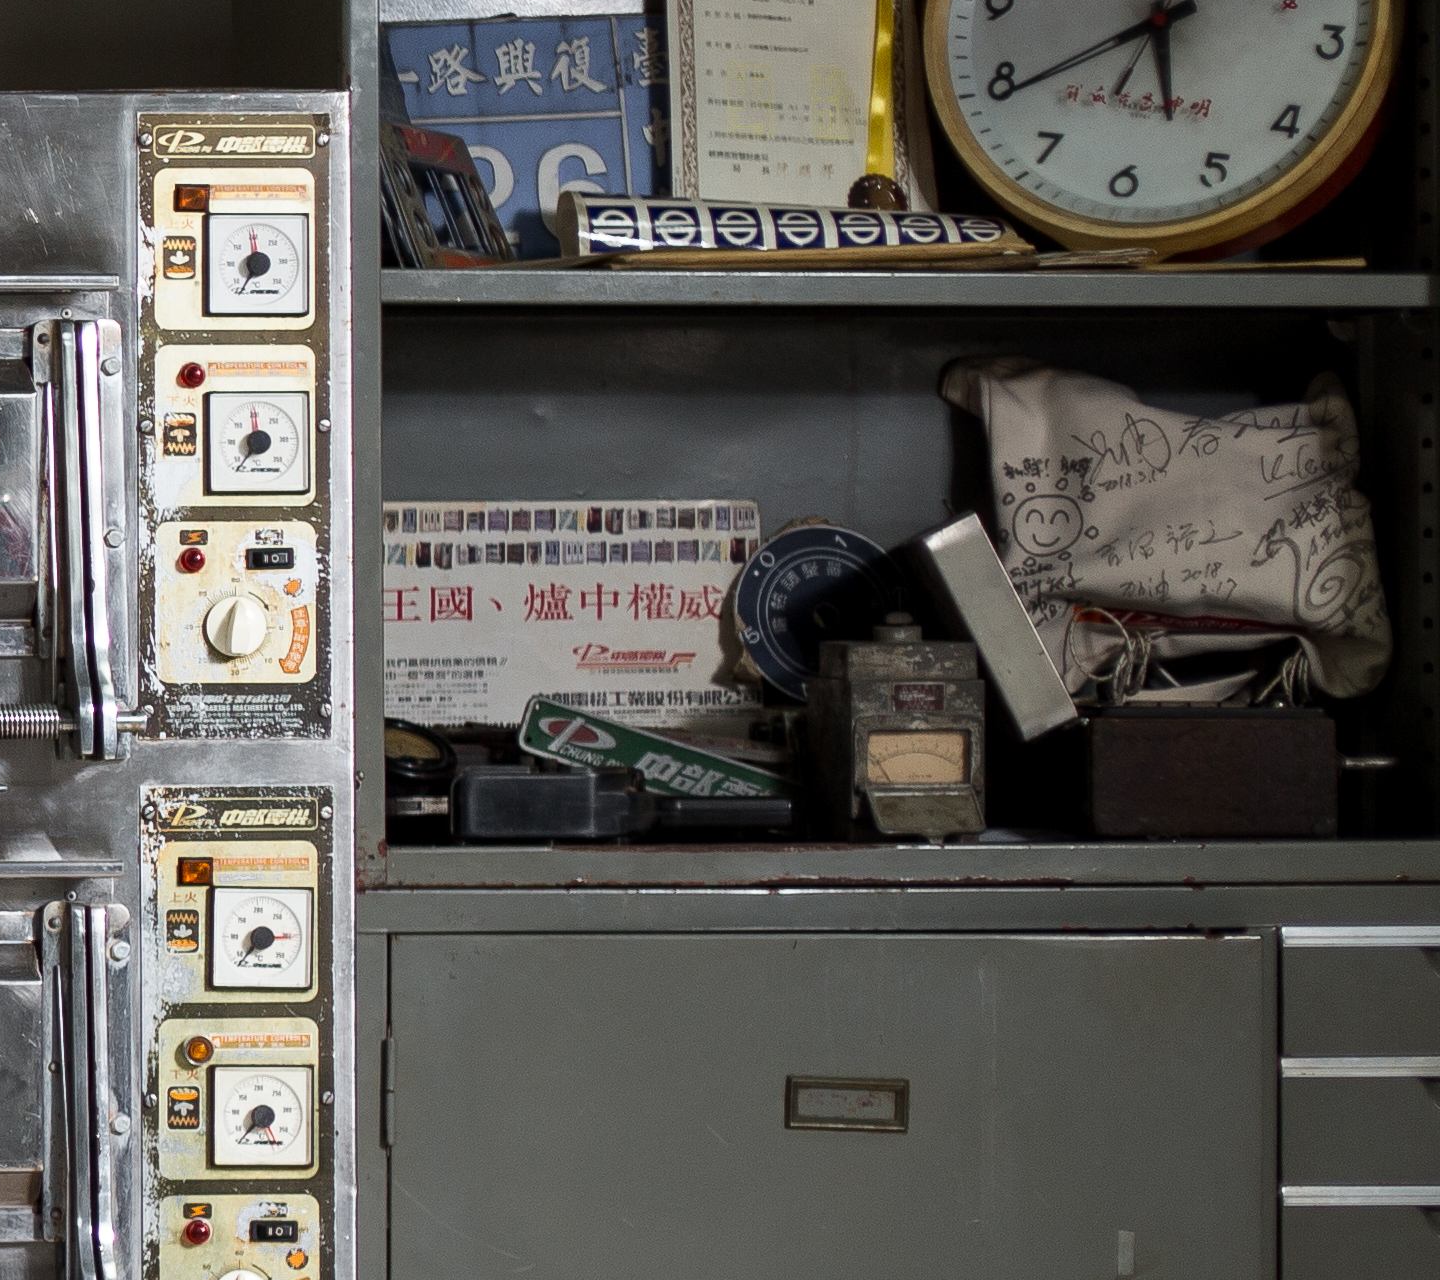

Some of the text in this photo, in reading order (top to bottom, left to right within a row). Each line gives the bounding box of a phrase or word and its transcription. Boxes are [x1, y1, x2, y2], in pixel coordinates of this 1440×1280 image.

[1316, 24, 1347, 60] 3
[987, 61, 1016, 100] 8
[1270, 104, 1301, 139] 4
[216, 135, 308, 153] 中部電機
[1037, 130, 1065, 164] 7
[1200, 151, 1230, 187] 5
[1109, 164, 1139, 197] 6
[165, 218, 194, 230] 上火
[166, 395, 195, 407] 下火
[759, 551, 776, 569] 0
[744, 625, 761, 645] 5
[560, 744, 606, 767] CHUNG
[220, 808, 310, 826] 中部電機
[169, 892, 198, 904] 上火
[172, 1069, 198, 1081] 下火
